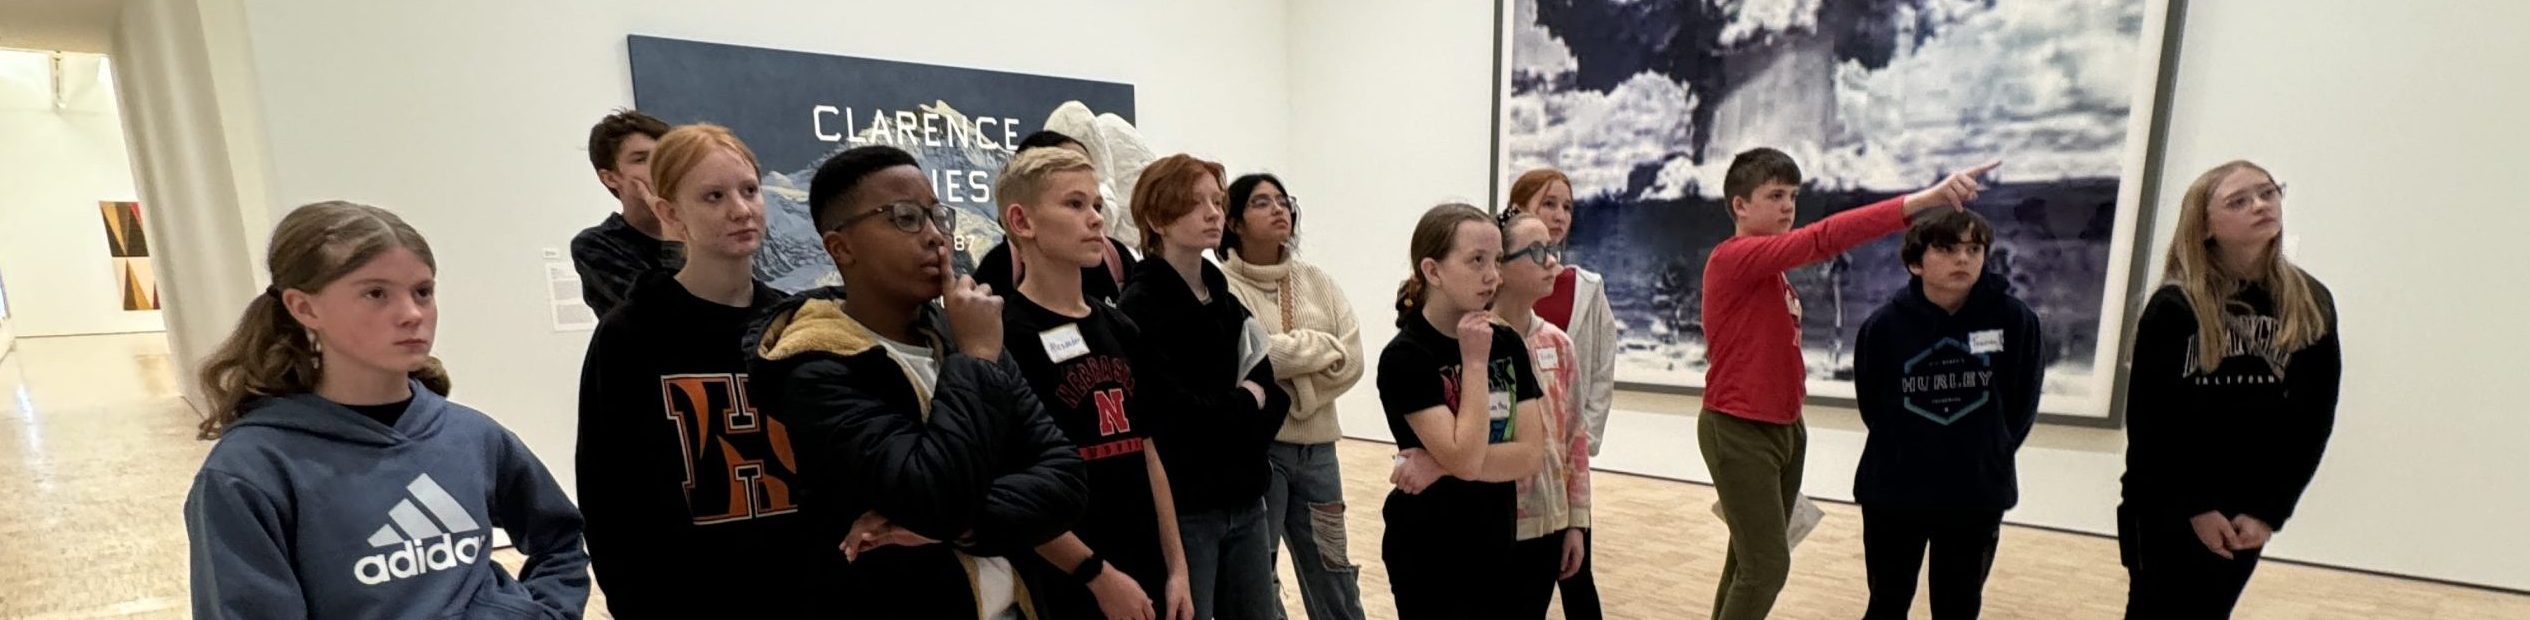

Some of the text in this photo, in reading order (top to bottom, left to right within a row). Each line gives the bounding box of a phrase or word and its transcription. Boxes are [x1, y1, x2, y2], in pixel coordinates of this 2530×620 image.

[813, 104, 1020, 150] CLARENCE
[1902, 370, 1993, 393] HURLEY
[1094, 388, 1130, 436] N
[354, 533, 485, 585] adida
